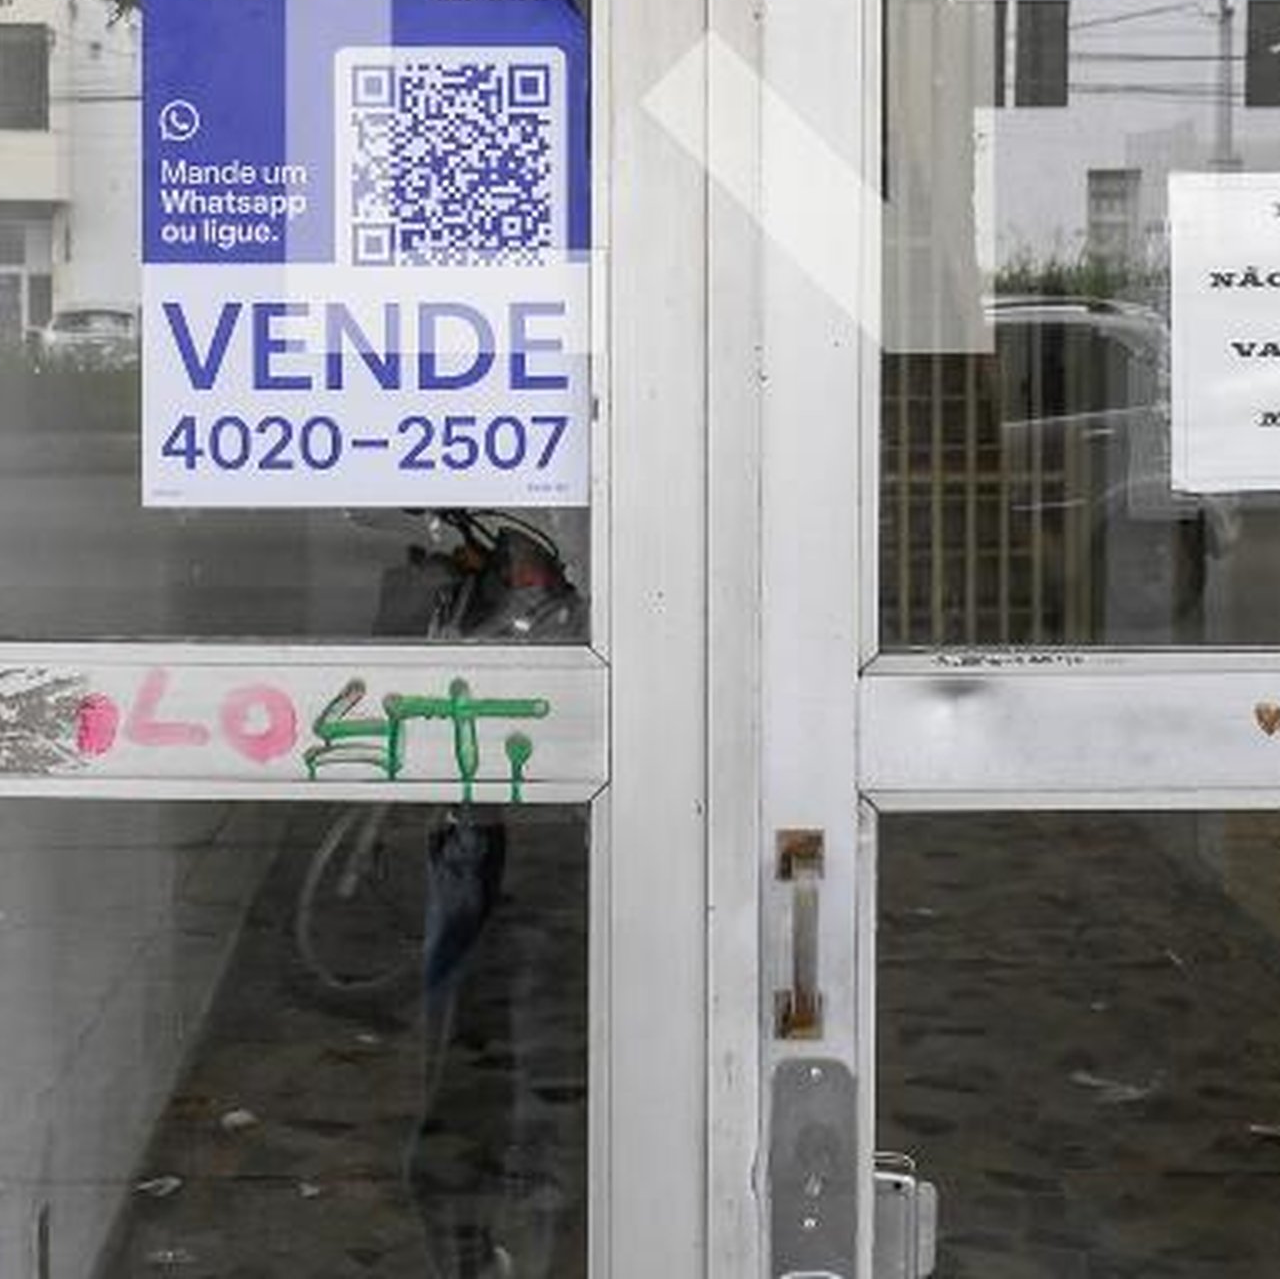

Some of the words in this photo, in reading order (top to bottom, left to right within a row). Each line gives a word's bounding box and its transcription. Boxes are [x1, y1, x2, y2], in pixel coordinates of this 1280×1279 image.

[160, 158, 257, 185] Mande
[263, 164, 308, 185] um
[160, 188, 308, 221] Whatsapp
[160, 224, 197, 244] ou
[203, 218, 280, 251] ligue.
[161, 301, 571, 392] VENDE
[161, 415, 570, 472] 4020-2507
